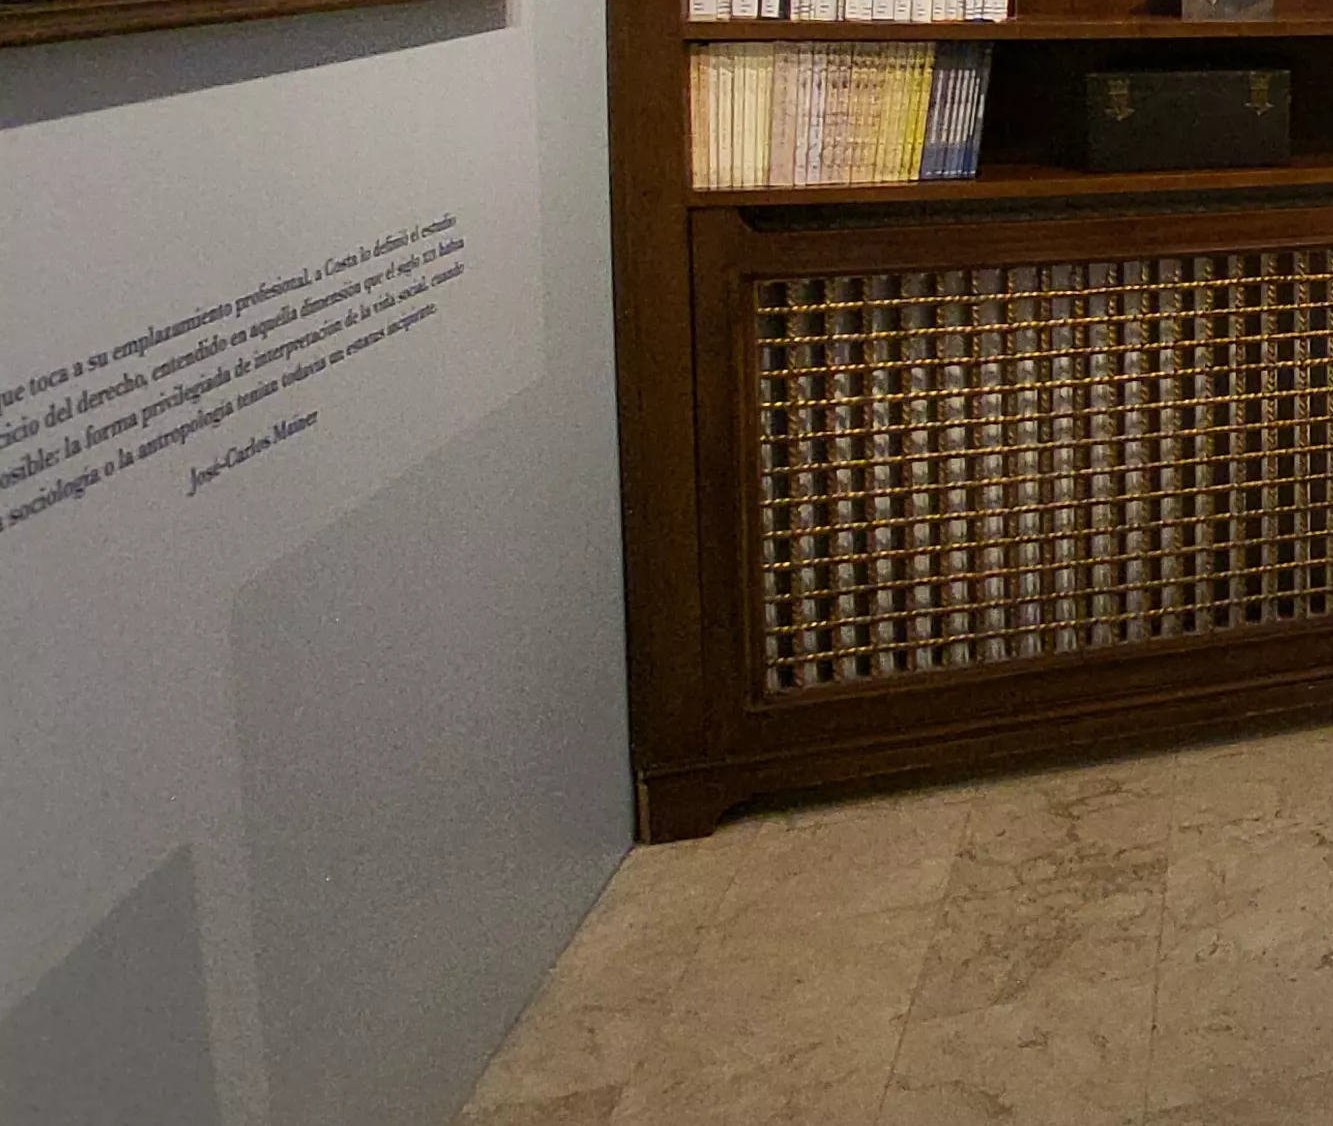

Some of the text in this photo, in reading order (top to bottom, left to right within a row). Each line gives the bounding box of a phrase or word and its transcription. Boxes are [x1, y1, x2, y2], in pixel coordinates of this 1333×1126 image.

[29, 368, 69, 395] toca
[72, 363, 84, 377] a
[86, 351, 108, 371] su
[112, 303, 232, 361] emplazamiento
[323, 254, 358, 276] Costa
[43, 396, 73, 428] del
[150, 335, 229, 381] entendido
[229, 330, 247, 346] en
[103, 462, 115, 476] o
[117, 448, 135, 470] la
